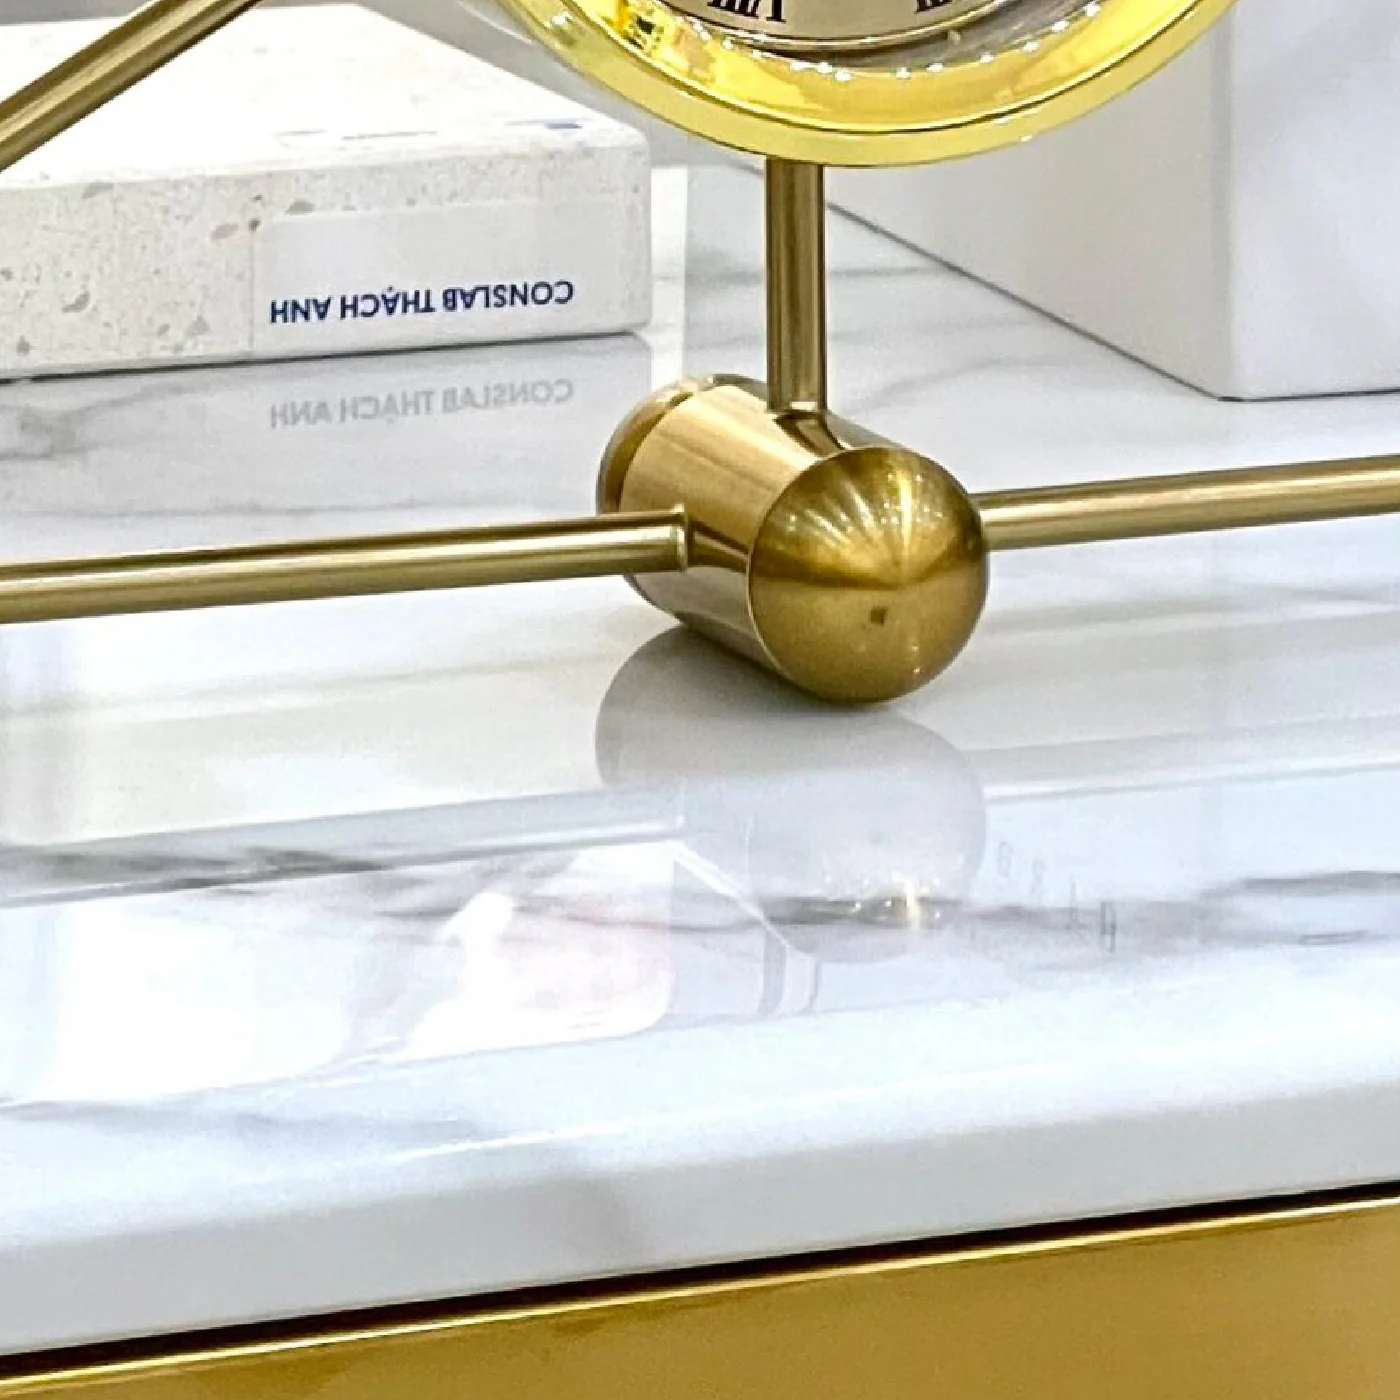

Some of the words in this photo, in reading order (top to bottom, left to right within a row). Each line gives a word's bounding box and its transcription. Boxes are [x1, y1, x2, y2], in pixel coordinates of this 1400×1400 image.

[270, 295, 332, 324] ANH
[339, 285, 436, 320] THẠCH
[442, 279, 575, 313] CONSLAB
